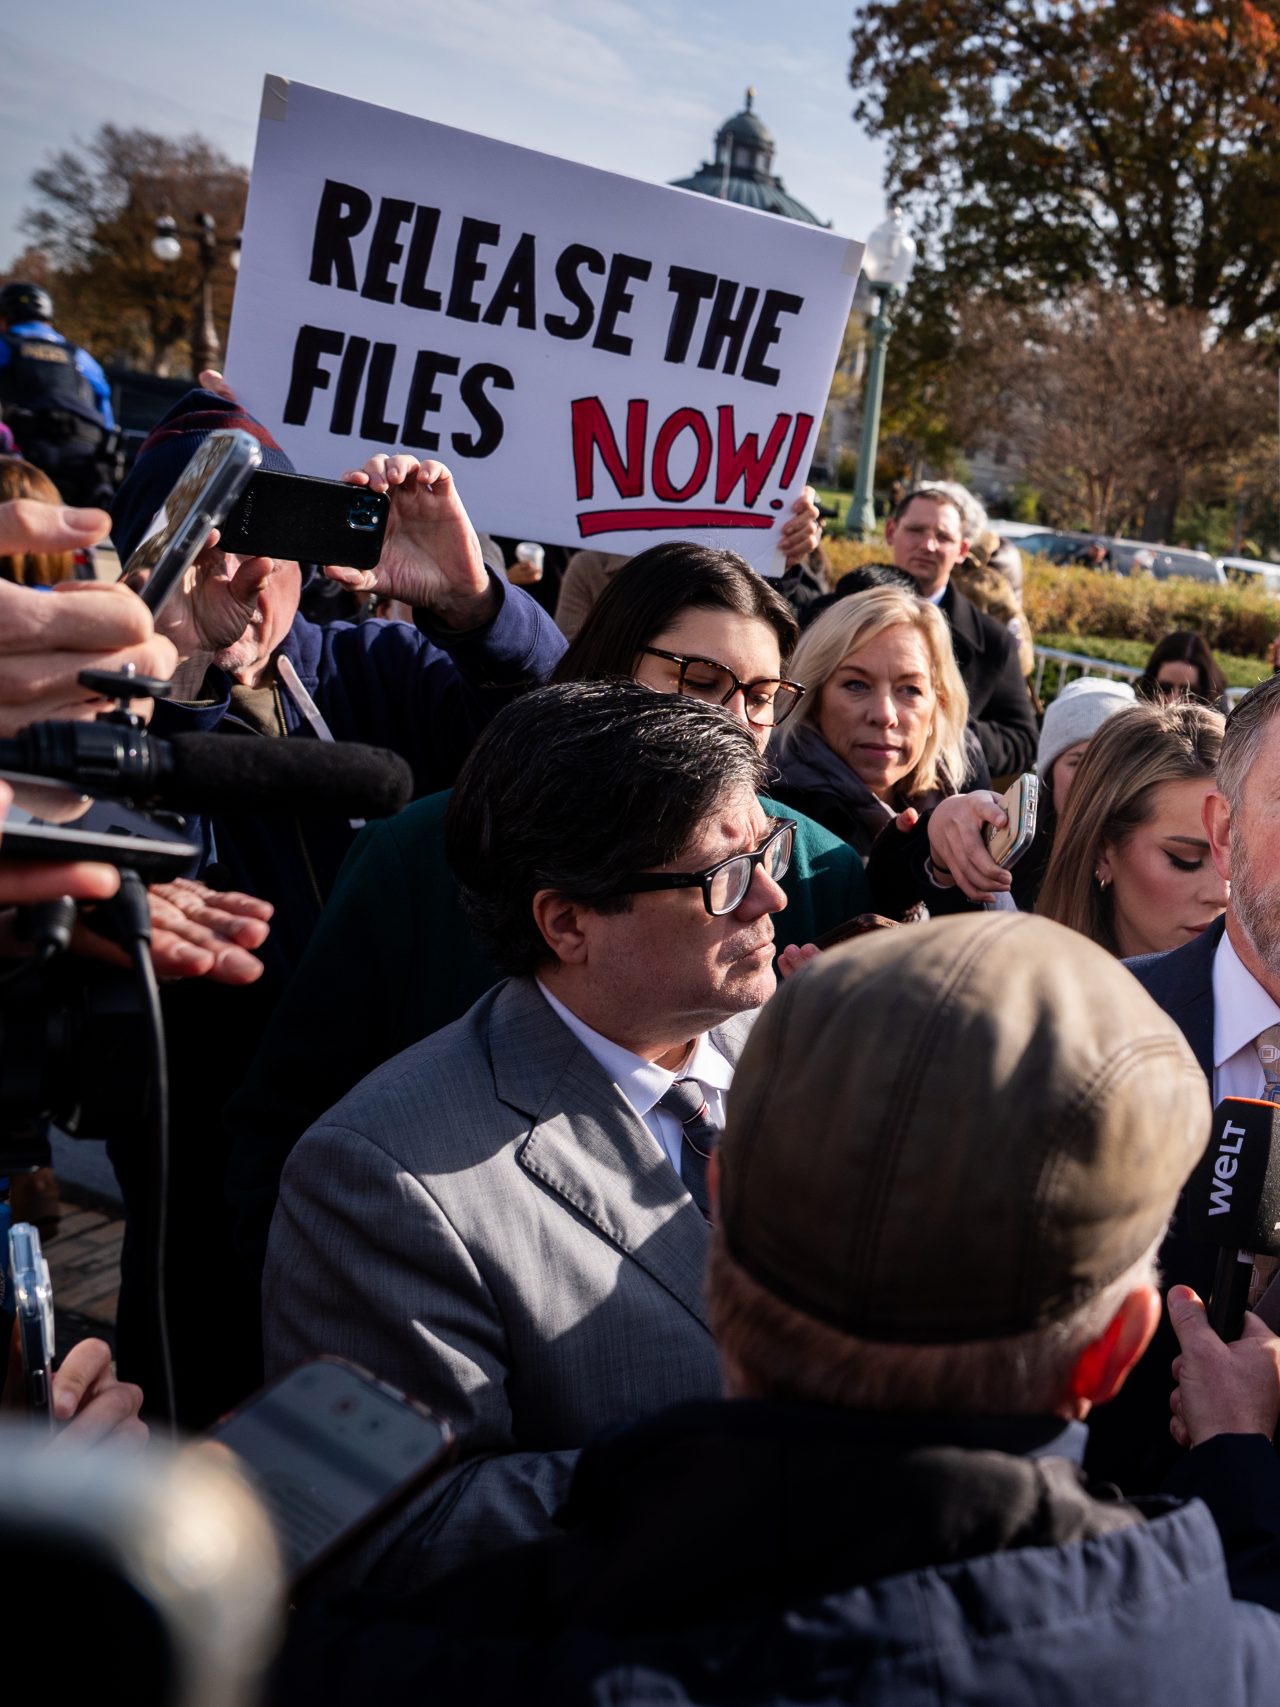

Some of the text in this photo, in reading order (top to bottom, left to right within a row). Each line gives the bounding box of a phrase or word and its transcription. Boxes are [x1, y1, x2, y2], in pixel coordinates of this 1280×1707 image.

[309, 179, 804, 386] RELEASE THE
[283, 325, 815, 508] FILES NOW!
